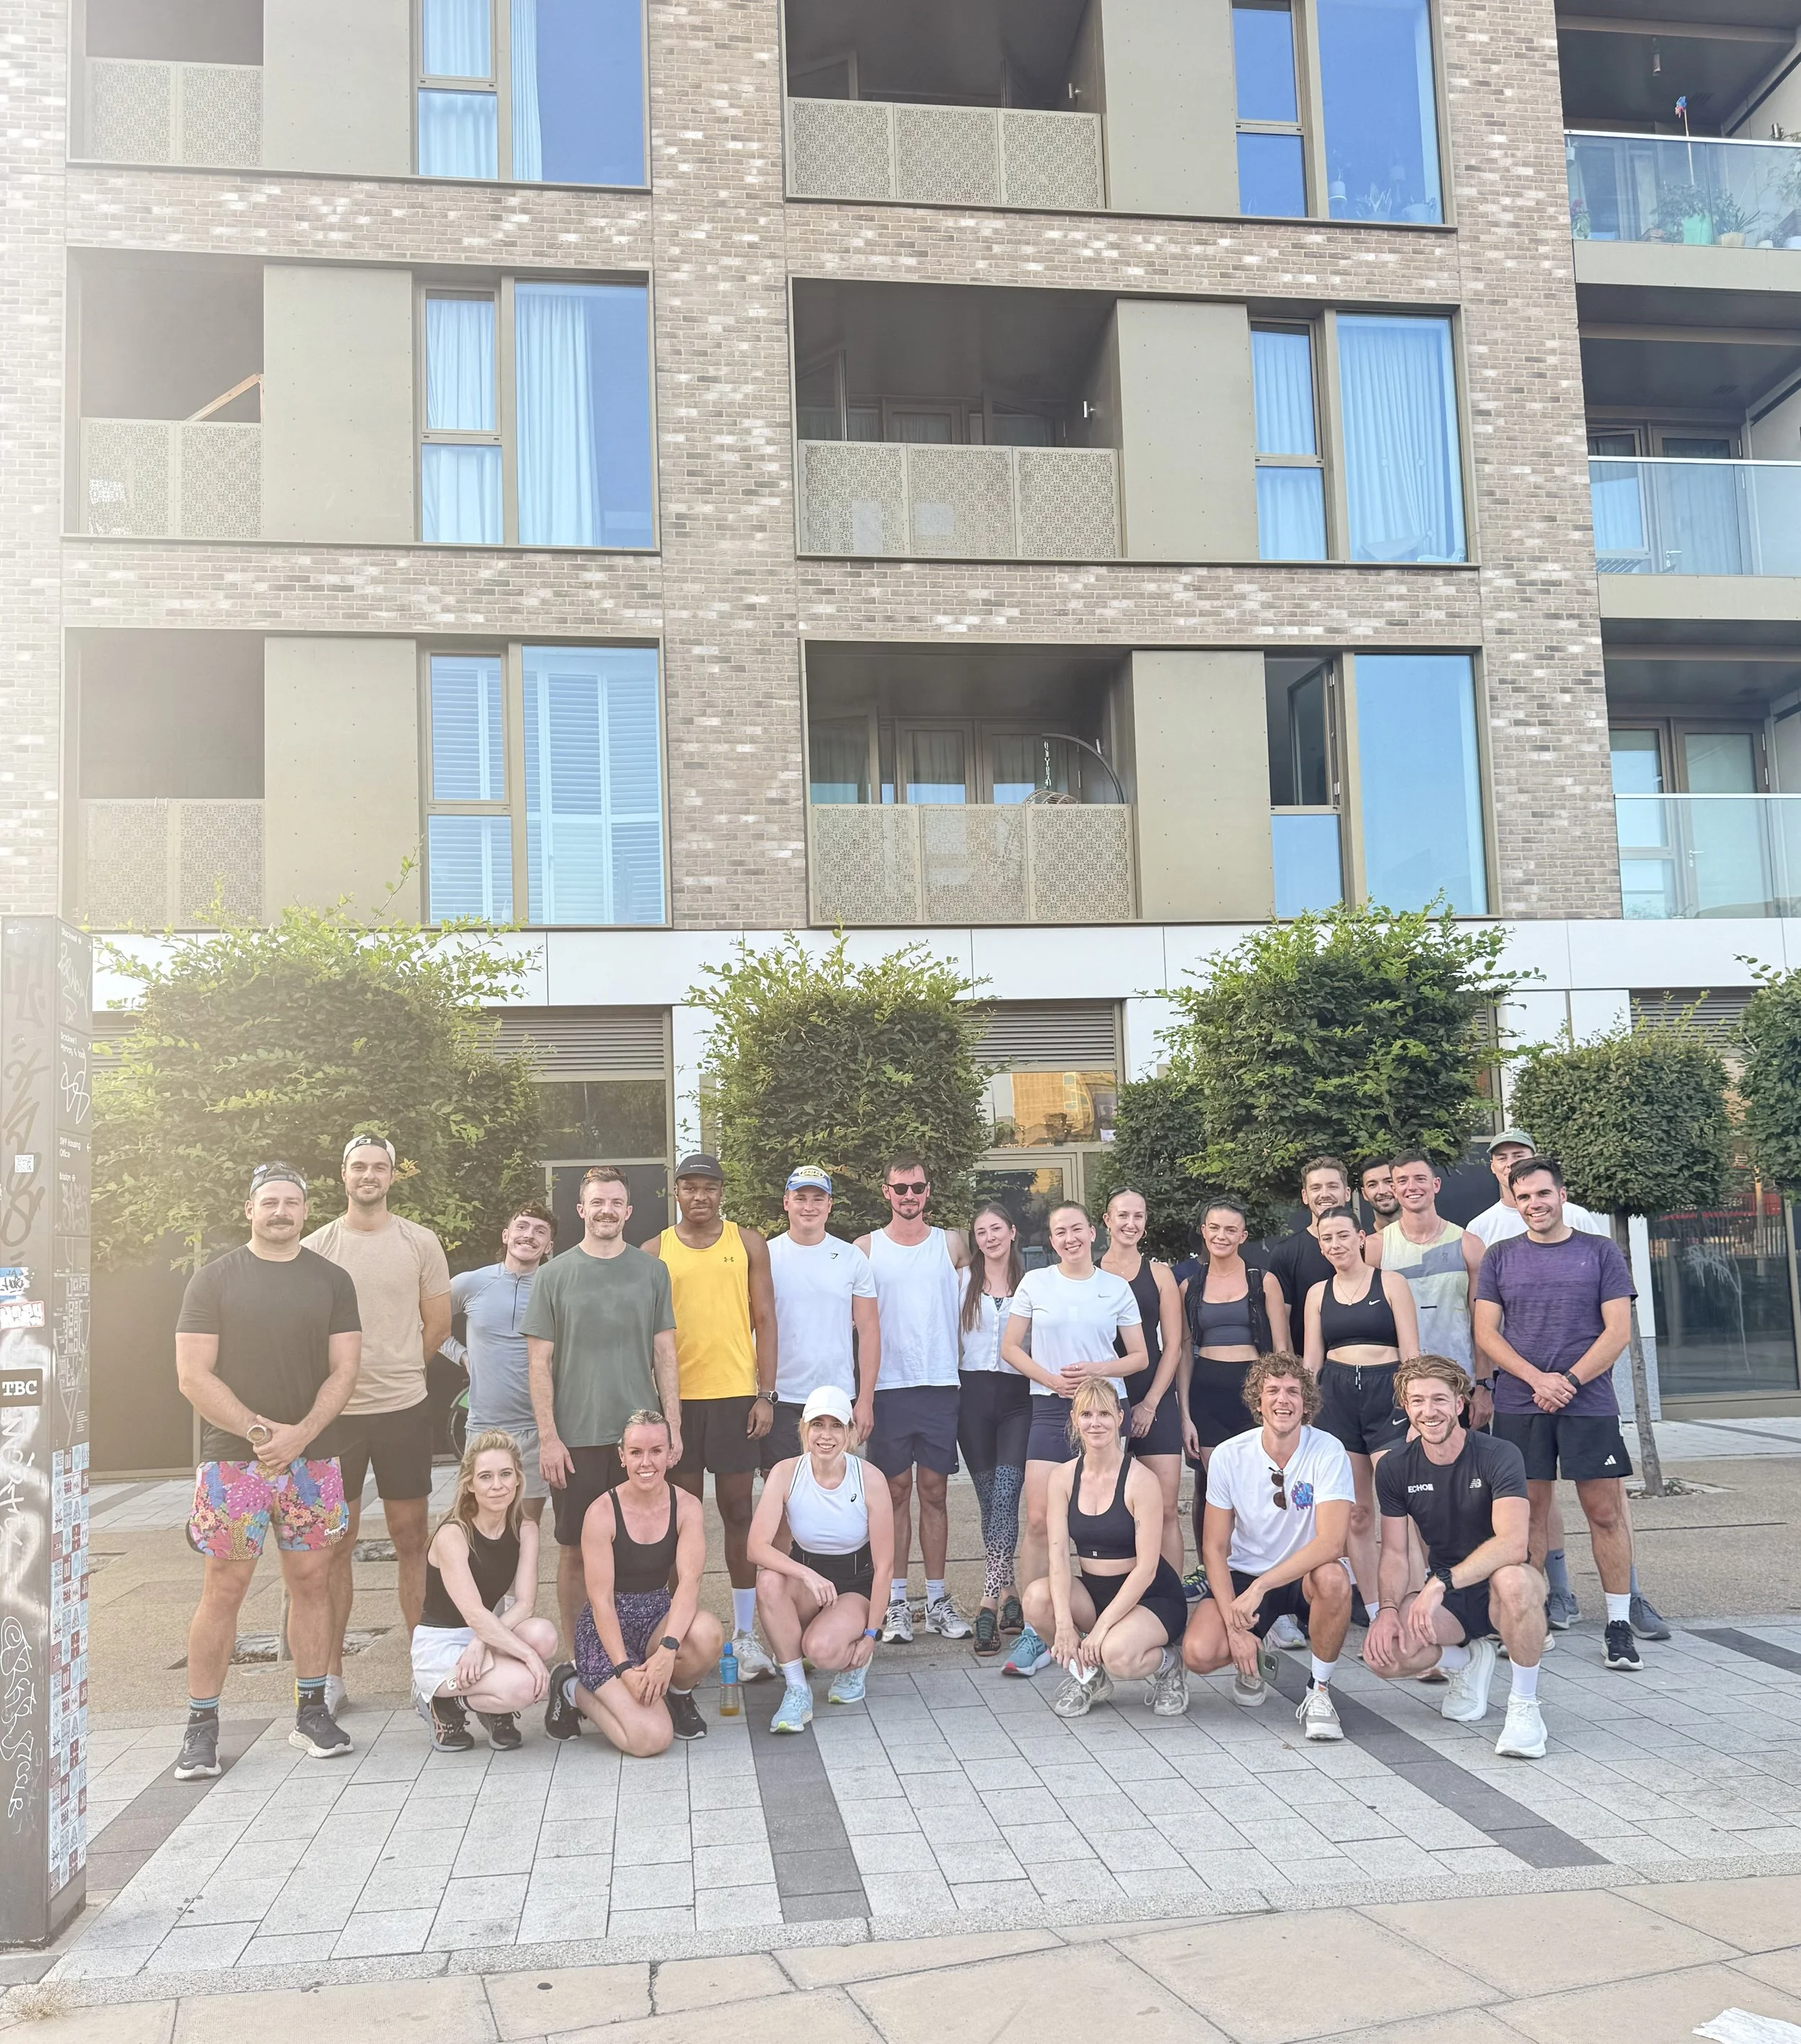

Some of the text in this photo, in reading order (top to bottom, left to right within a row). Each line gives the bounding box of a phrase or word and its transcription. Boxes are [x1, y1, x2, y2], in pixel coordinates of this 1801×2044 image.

[67, 1139, 81, 1151] Housing
[59, 1148, 70, 1158] Office
[59, 1172, 71, 1181] Brixton
[2, 1380, 37, 1397] TBC
